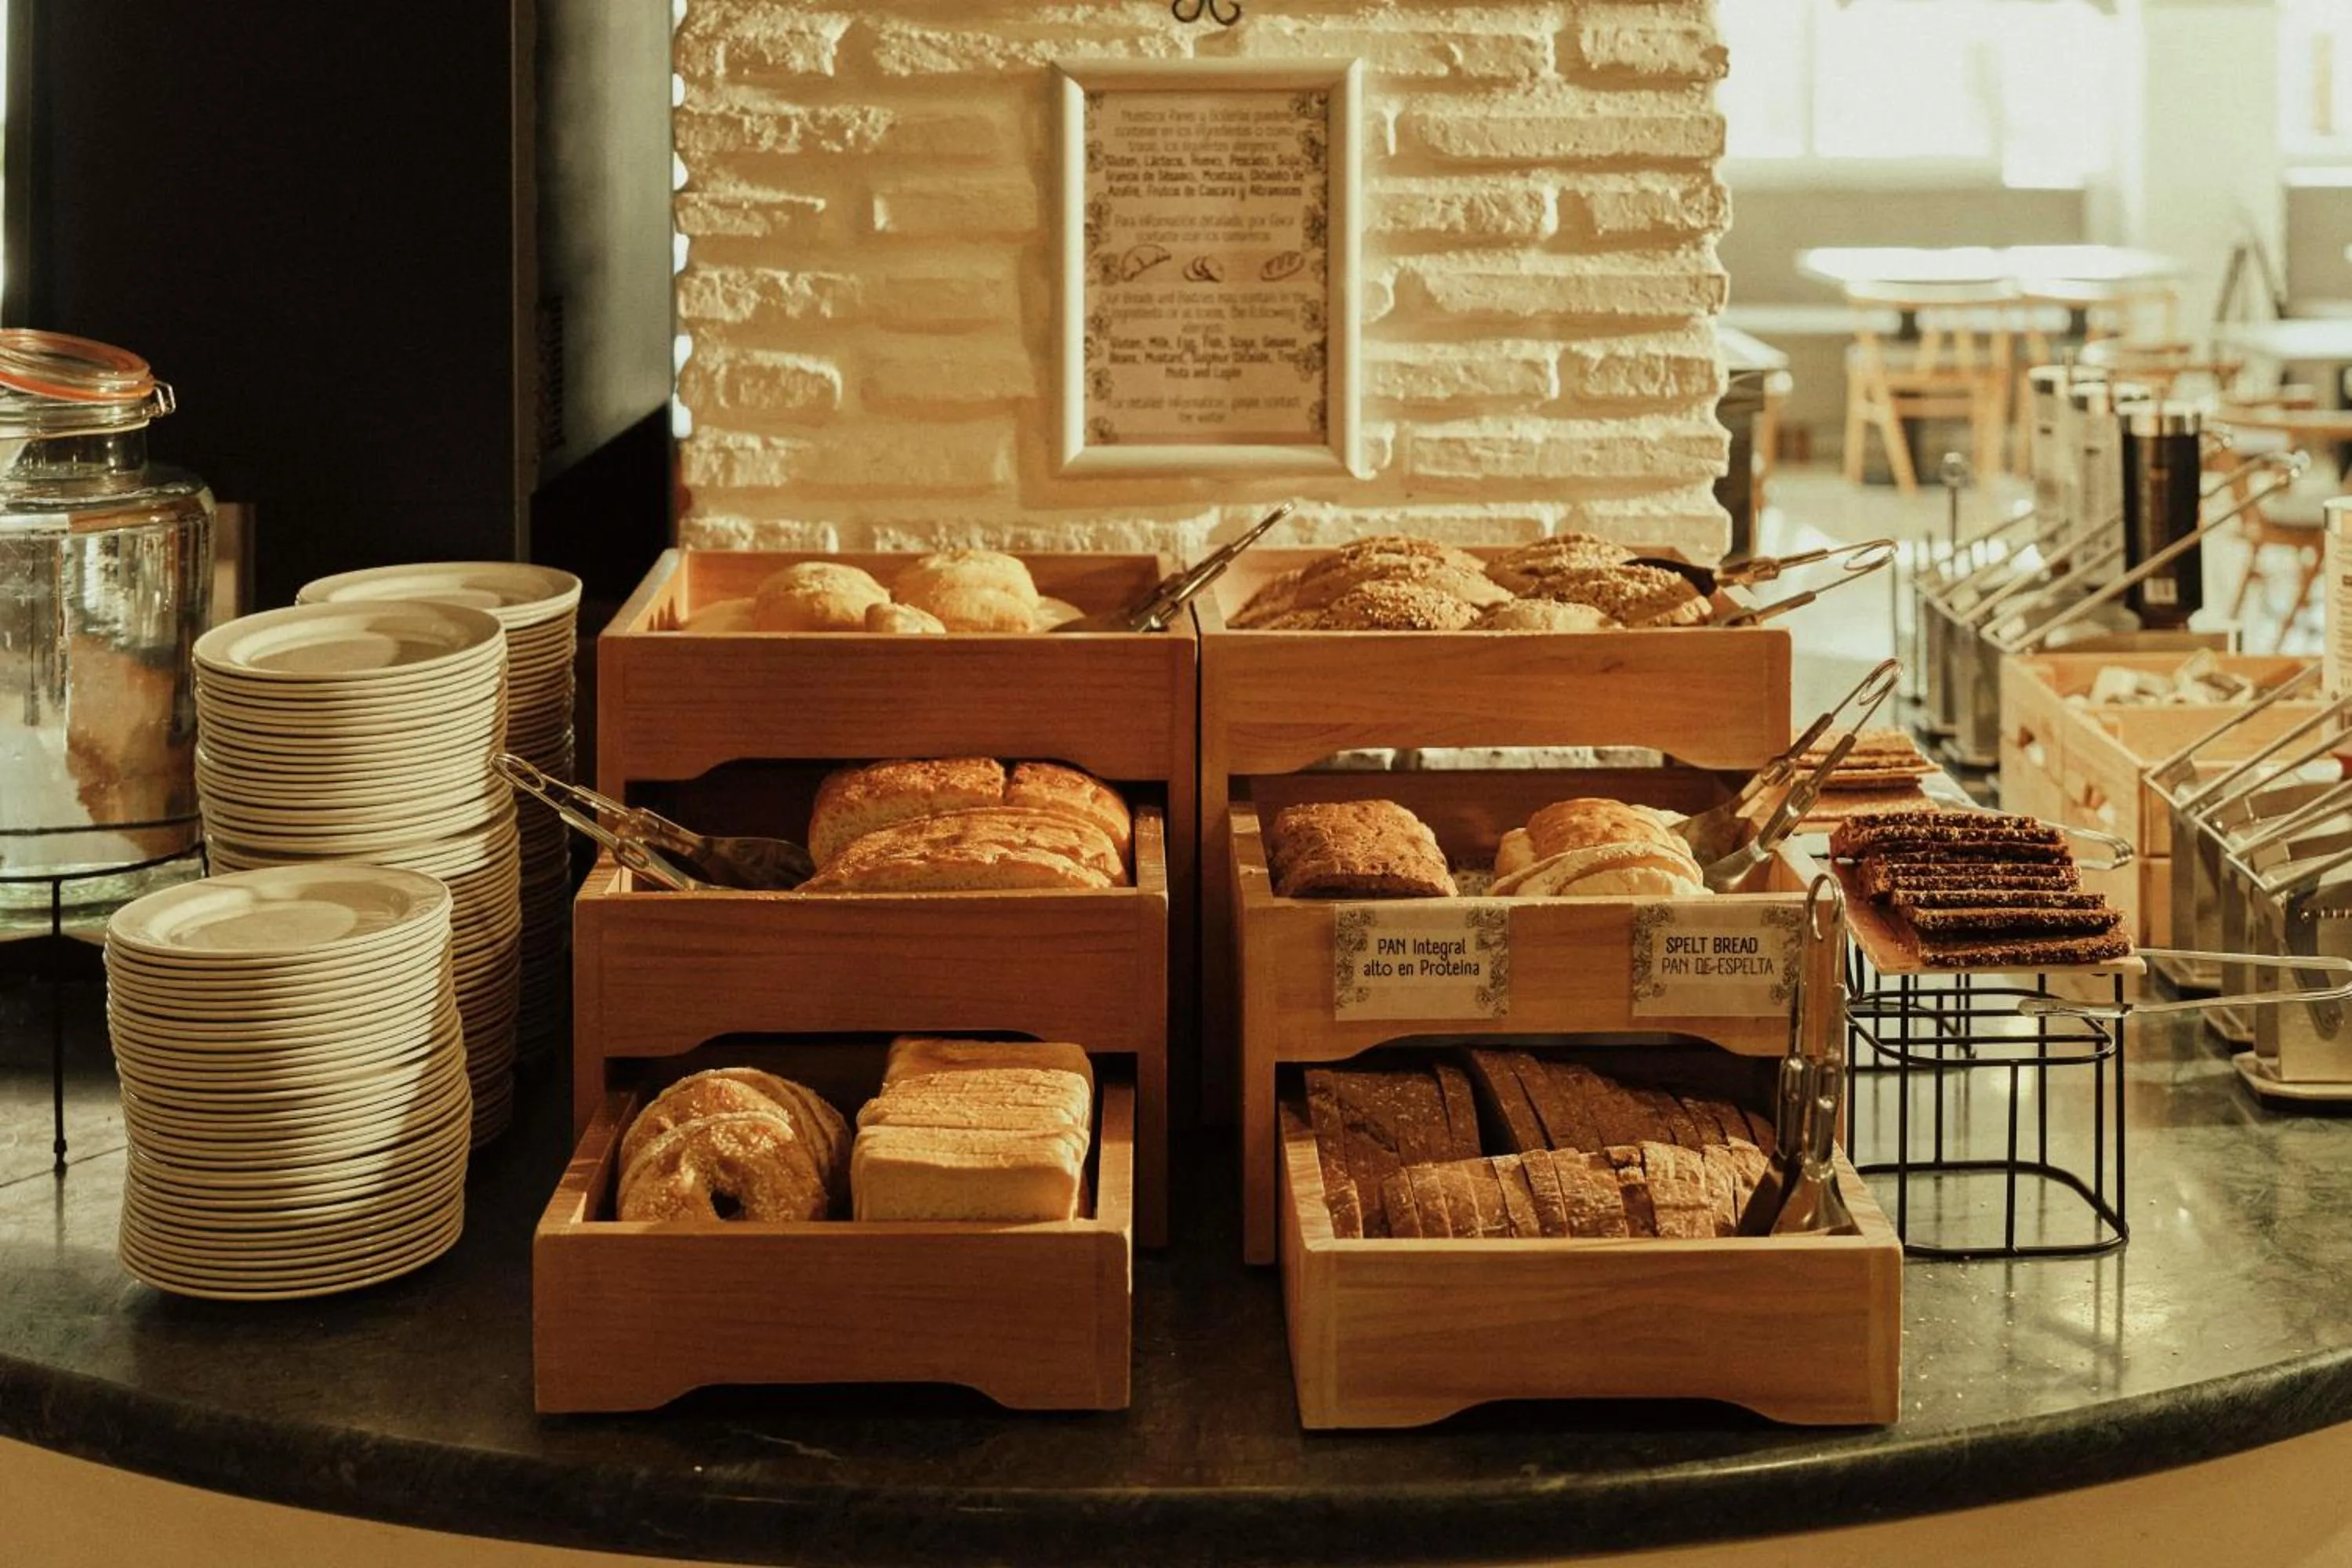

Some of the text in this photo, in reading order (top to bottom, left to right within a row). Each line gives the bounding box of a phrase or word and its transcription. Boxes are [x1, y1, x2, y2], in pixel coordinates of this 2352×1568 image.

[1377, 937, 1466, 961] PAN Integral
[1665, 936, 1759, 954] SPELT BREAD
[1363, 959, 1393, 976] alto
[1398, 963, 1414, 976] en
[1661, 956, 1689, 975] PAN
